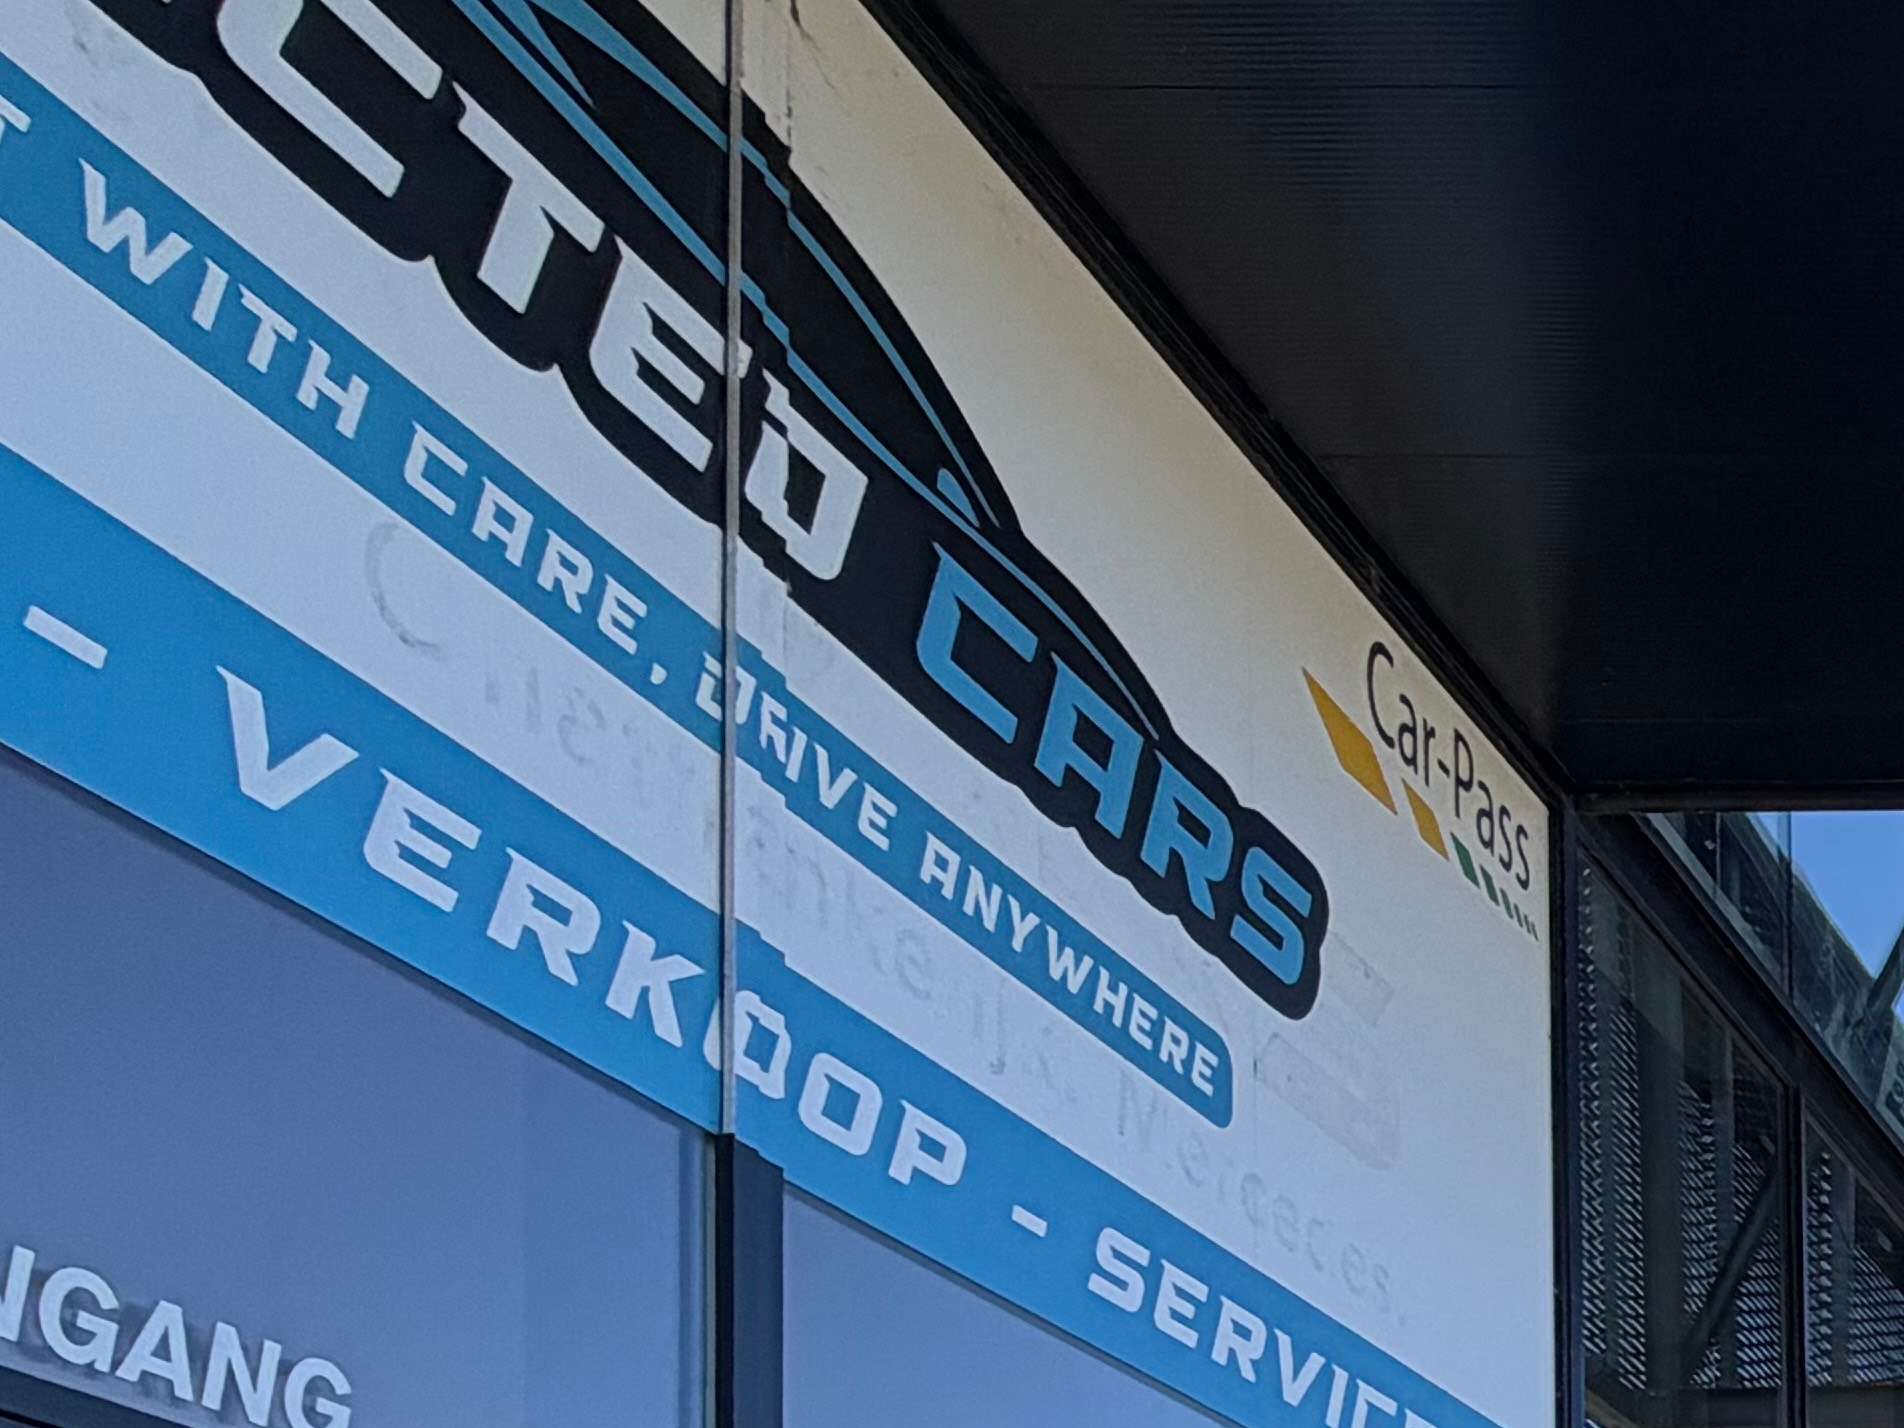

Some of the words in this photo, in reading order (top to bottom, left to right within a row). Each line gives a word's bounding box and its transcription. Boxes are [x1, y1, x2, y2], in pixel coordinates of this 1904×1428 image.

[79, 157, 370, 440] WITH
[403, 420, 669, 686] CARE,
[695, 651, 891, 851] DRIVE
[920, 831, 1220, 1093] ANYWHERE
[914, 541, 1313, 986] CARS
[1366, 641, 1532, 892] Car-Pass
[215, 664, 968, 1187] VERKOOP
